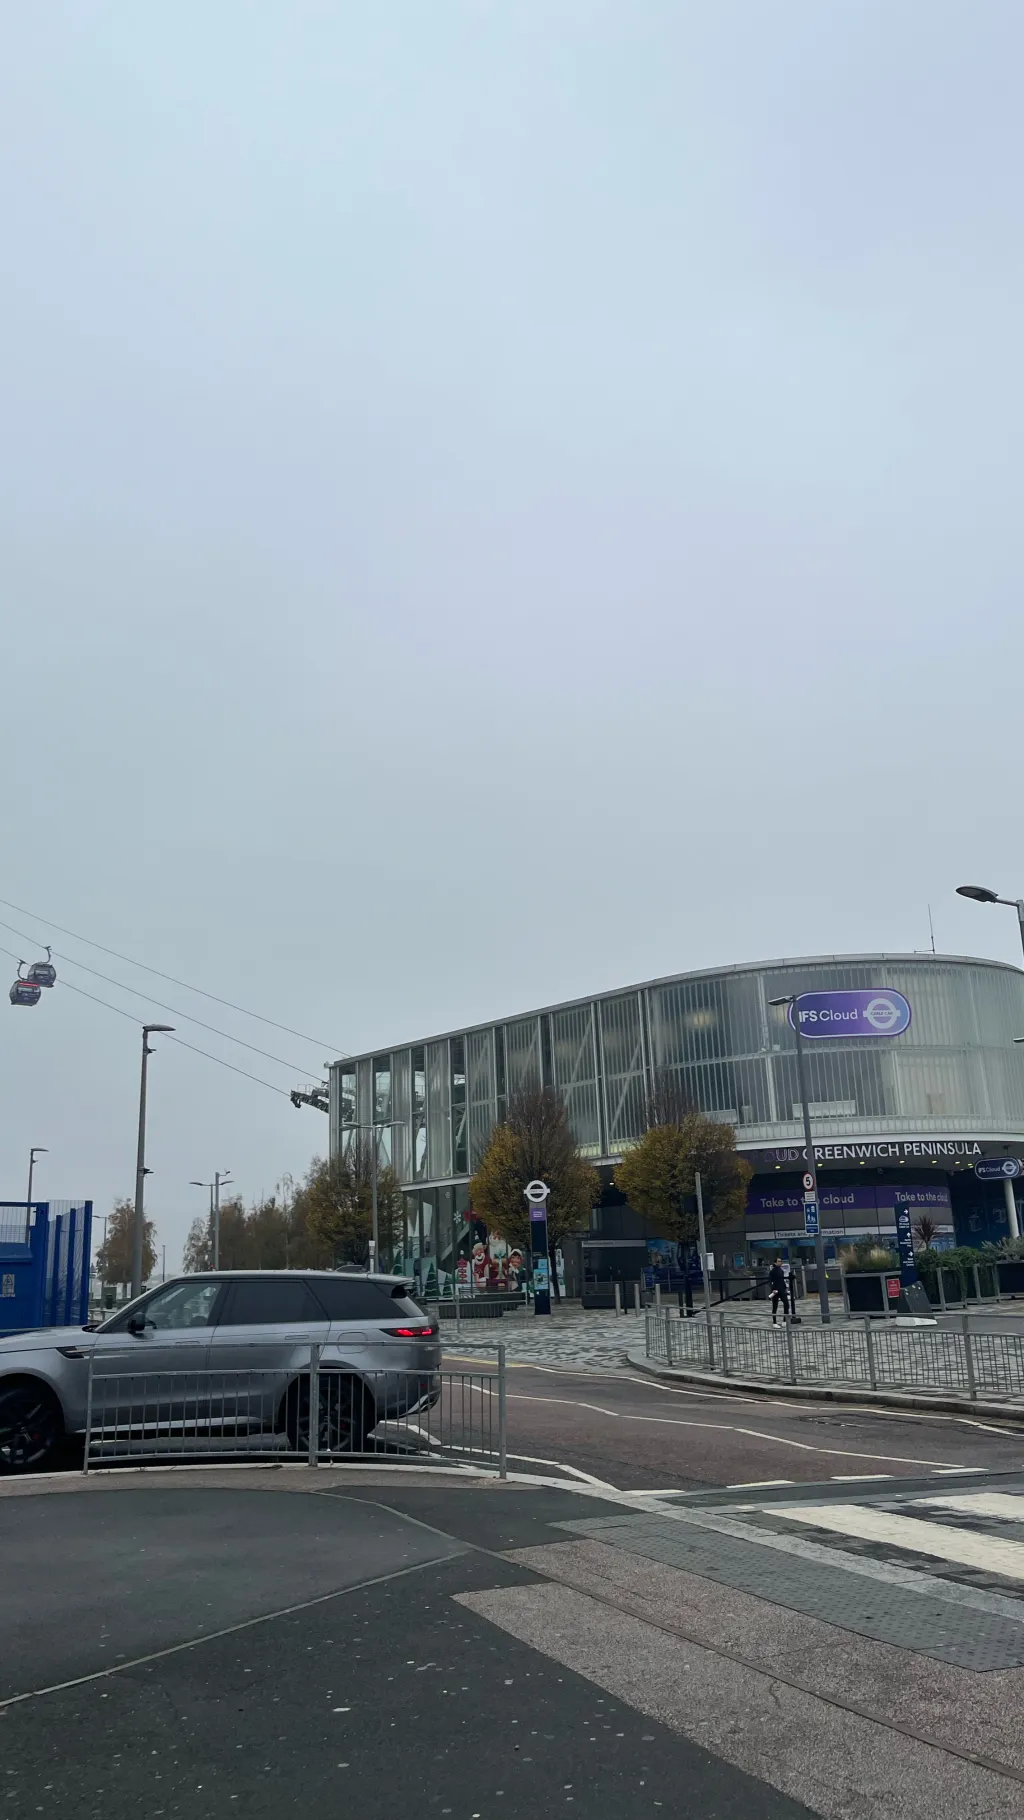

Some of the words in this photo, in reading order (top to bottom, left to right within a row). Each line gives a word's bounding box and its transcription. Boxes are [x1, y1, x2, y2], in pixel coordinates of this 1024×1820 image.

[799, 1010, 818, 1023] IFS
[819, 1008, 859, 1021] Cloud
[904, 1141, 981, 1156] PENINSULA
[805, 1176, 811, 1186] 5
[760, 1197, 785, 1208] Take
[787, 1197, 798, 1206] to
[823, 1193, 855, 1204] cloud
[894, 1191, 916, 1202] Take
[916, 1192, 925, 1201] to
[925, 1192, 937, 1201] the
